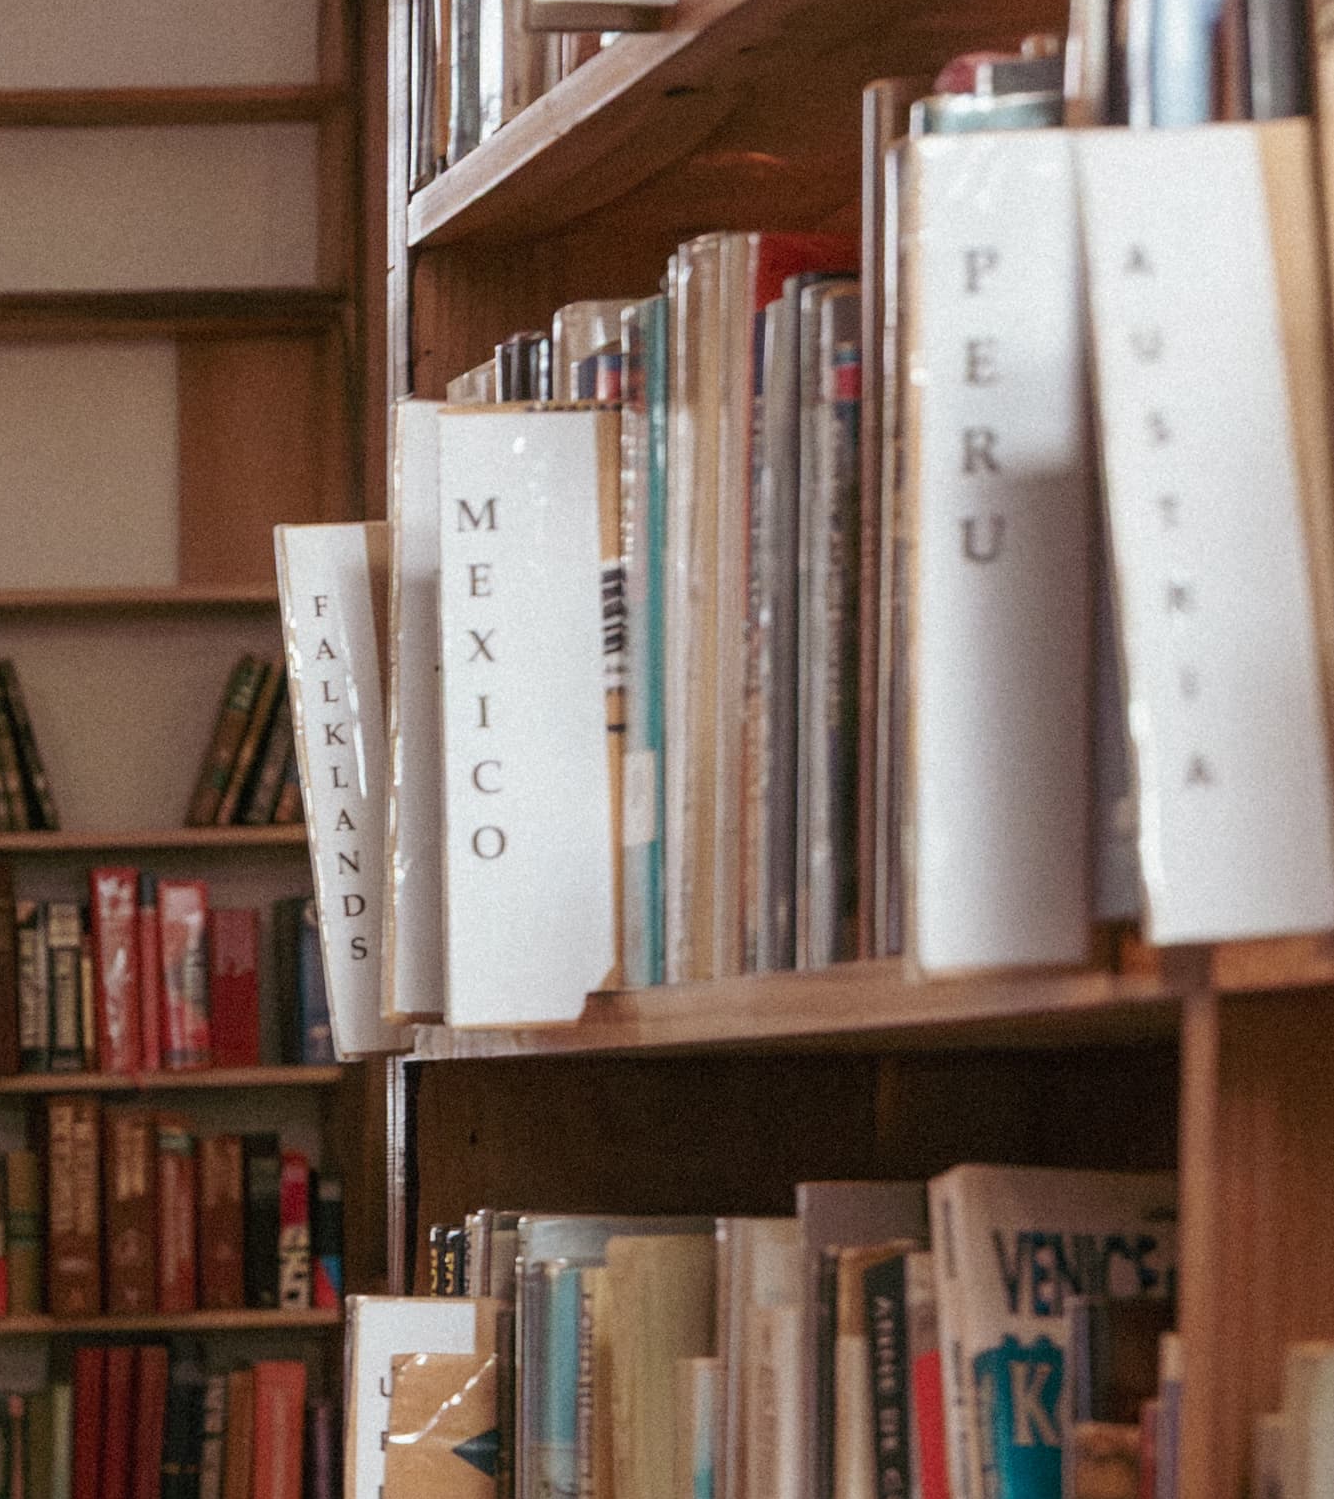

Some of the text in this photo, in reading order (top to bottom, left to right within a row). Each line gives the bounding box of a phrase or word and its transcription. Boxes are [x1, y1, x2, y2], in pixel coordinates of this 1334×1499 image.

[961, 244, 1008, 566] PERU
[311, 593, 370, 962] FALKLANDS
[455, 496, 509, 861] MEXICO
